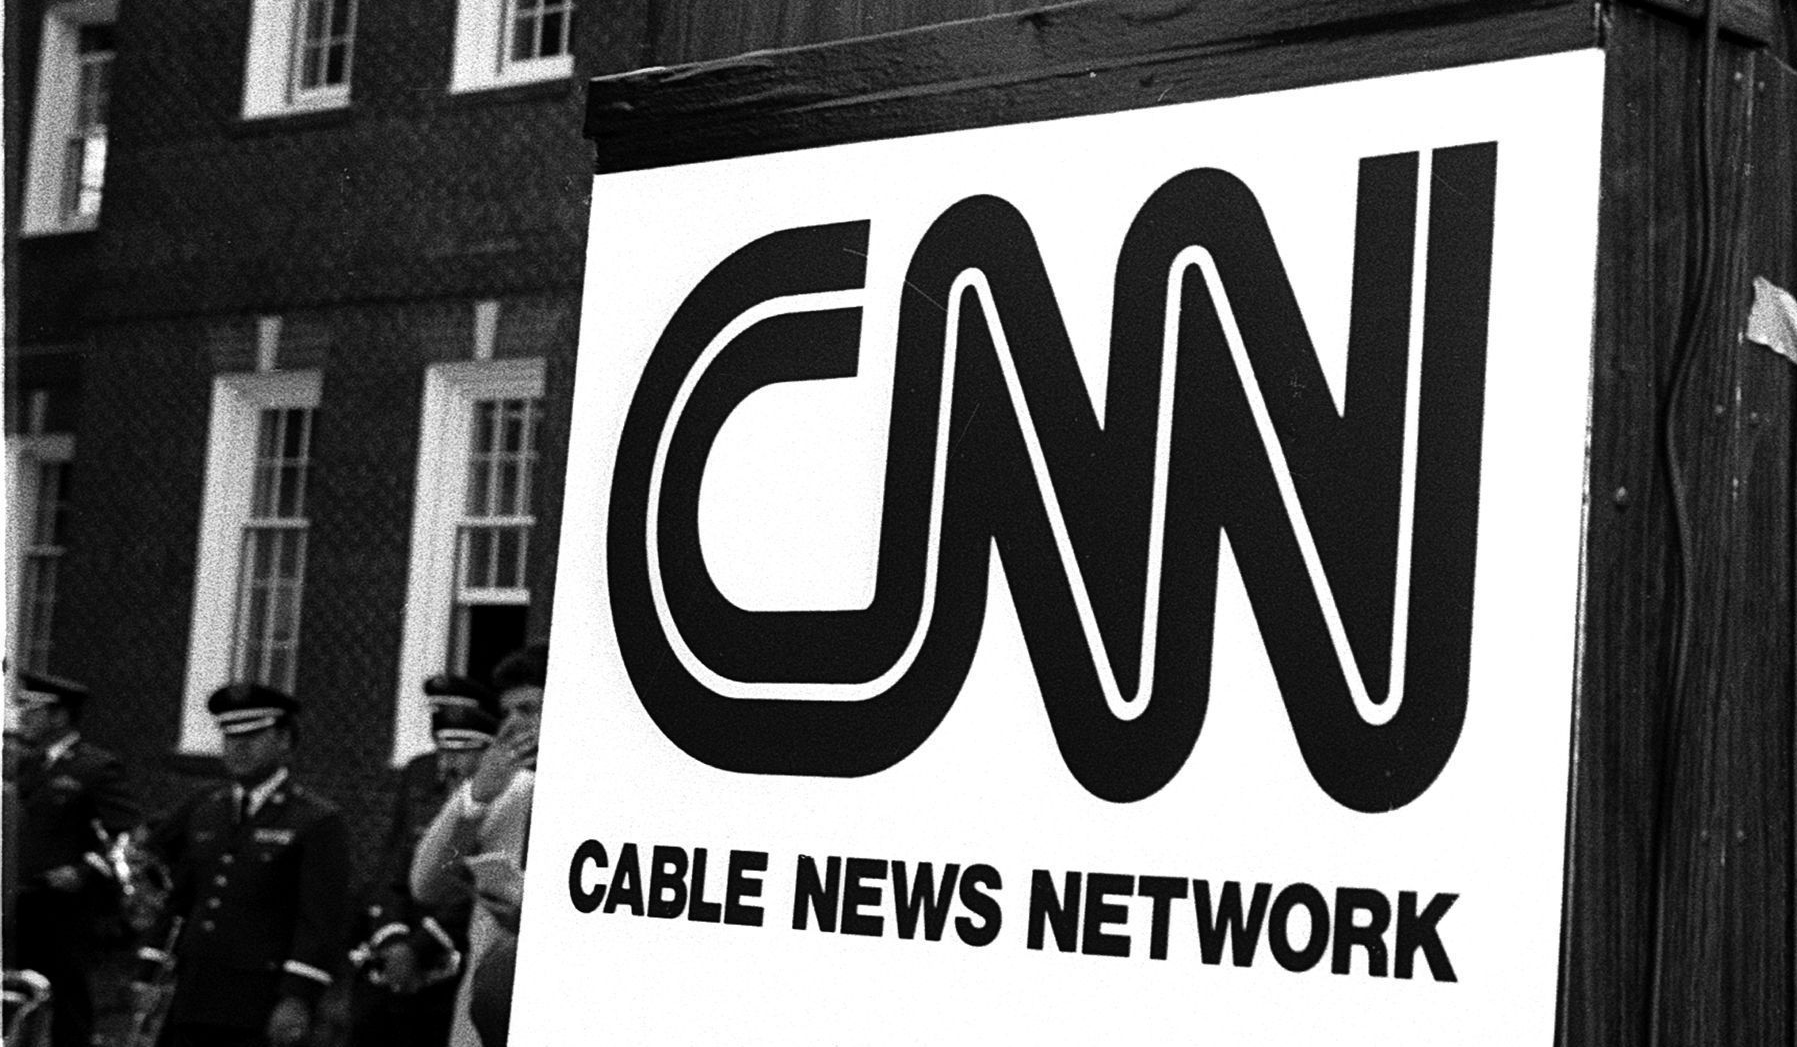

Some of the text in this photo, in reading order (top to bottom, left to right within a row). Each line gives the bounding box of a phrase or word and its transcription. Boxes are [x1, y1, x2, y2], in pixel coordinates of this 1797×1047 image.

[607, 140, 1498, 814] CNN
[568, 839, 1460, 983] CABLE NEWS NETWORK
